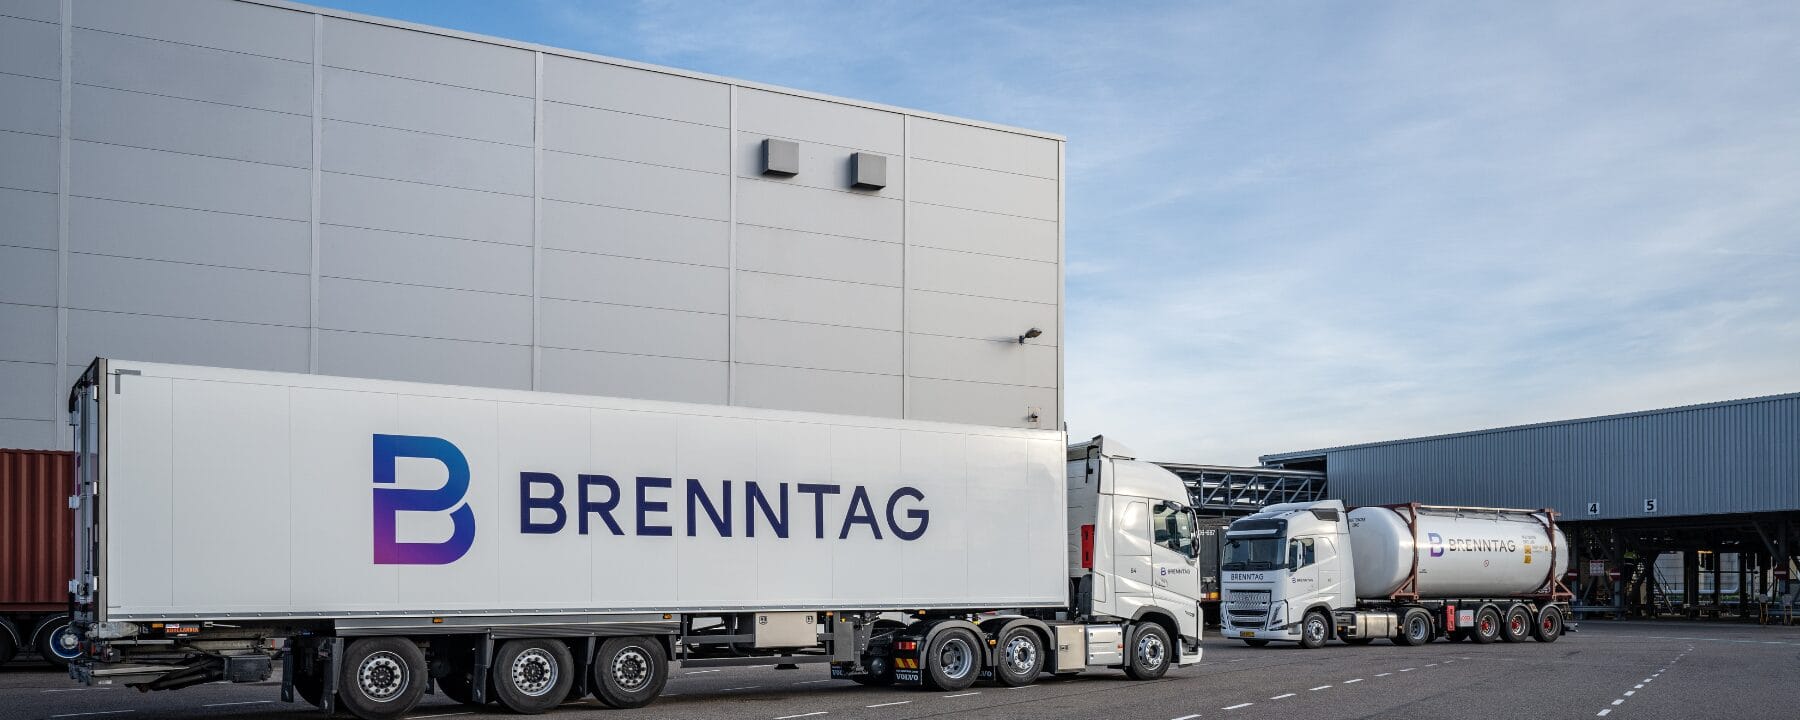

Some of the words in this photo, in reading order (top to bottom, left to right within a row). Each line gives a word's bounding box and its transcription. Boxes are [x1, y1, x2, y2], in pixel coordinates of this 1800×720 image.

[373, 434, 476, 565] B
[520, 471, 930, 541] BRENNTAG
[1589, 503, 1598, 513] 4
[1647, 500, 1655, 511] 5
[1448, 538, 1516, 553] BRENNTAG
[1230, 573, 1264, 581] BRENNTAG
[895, 673, 919, 681] VOLVO
